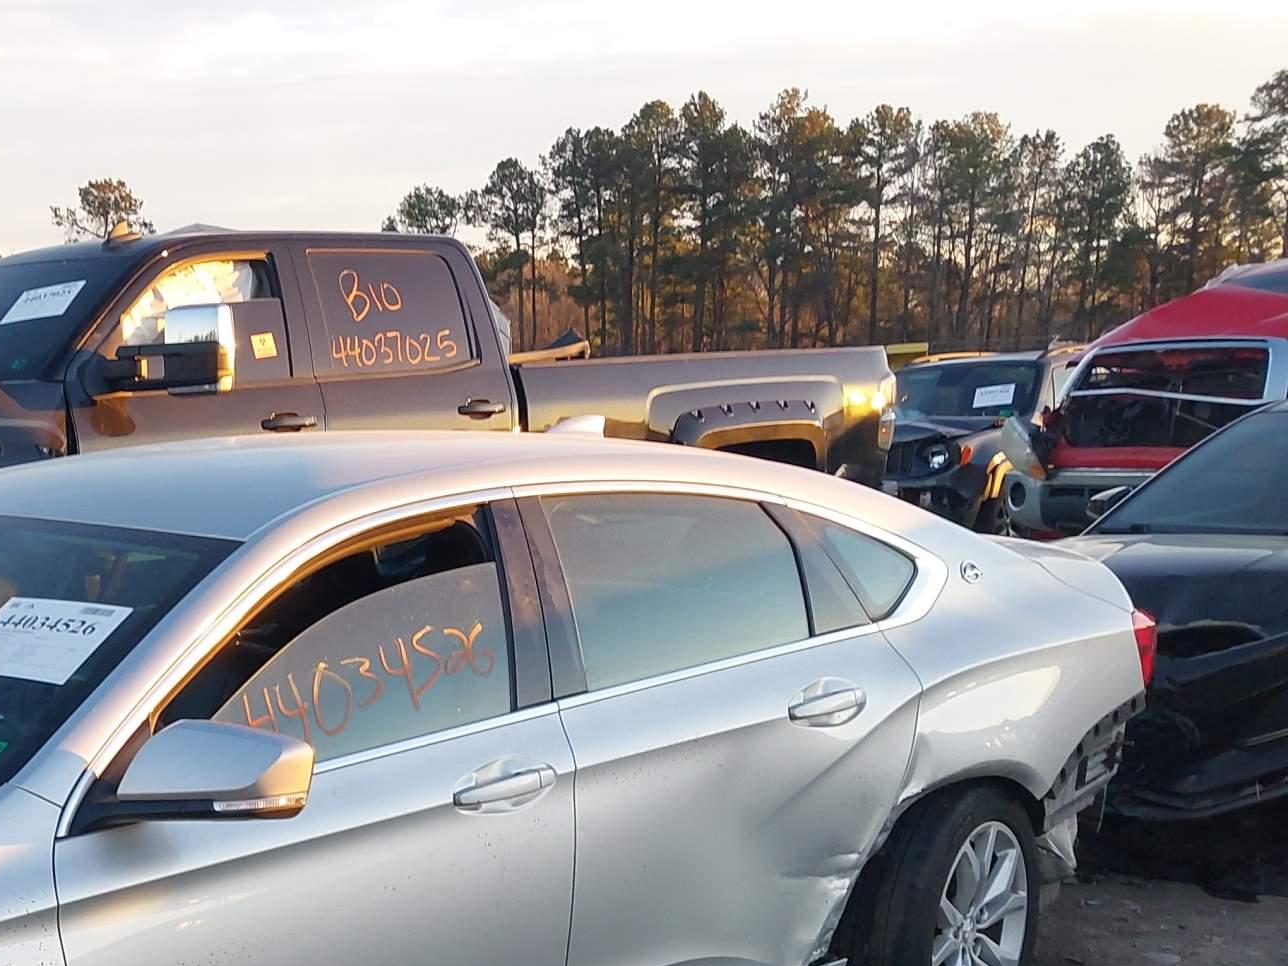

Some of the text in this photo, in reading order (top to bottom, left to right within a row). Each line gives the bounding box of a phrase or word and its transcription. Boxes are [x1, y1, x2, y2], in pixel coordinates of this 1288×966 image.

[332, 328, 457, 368] 44037025
[0, 613, 99, 637] 44034526
[242, 622, 497, 743] 44034526
